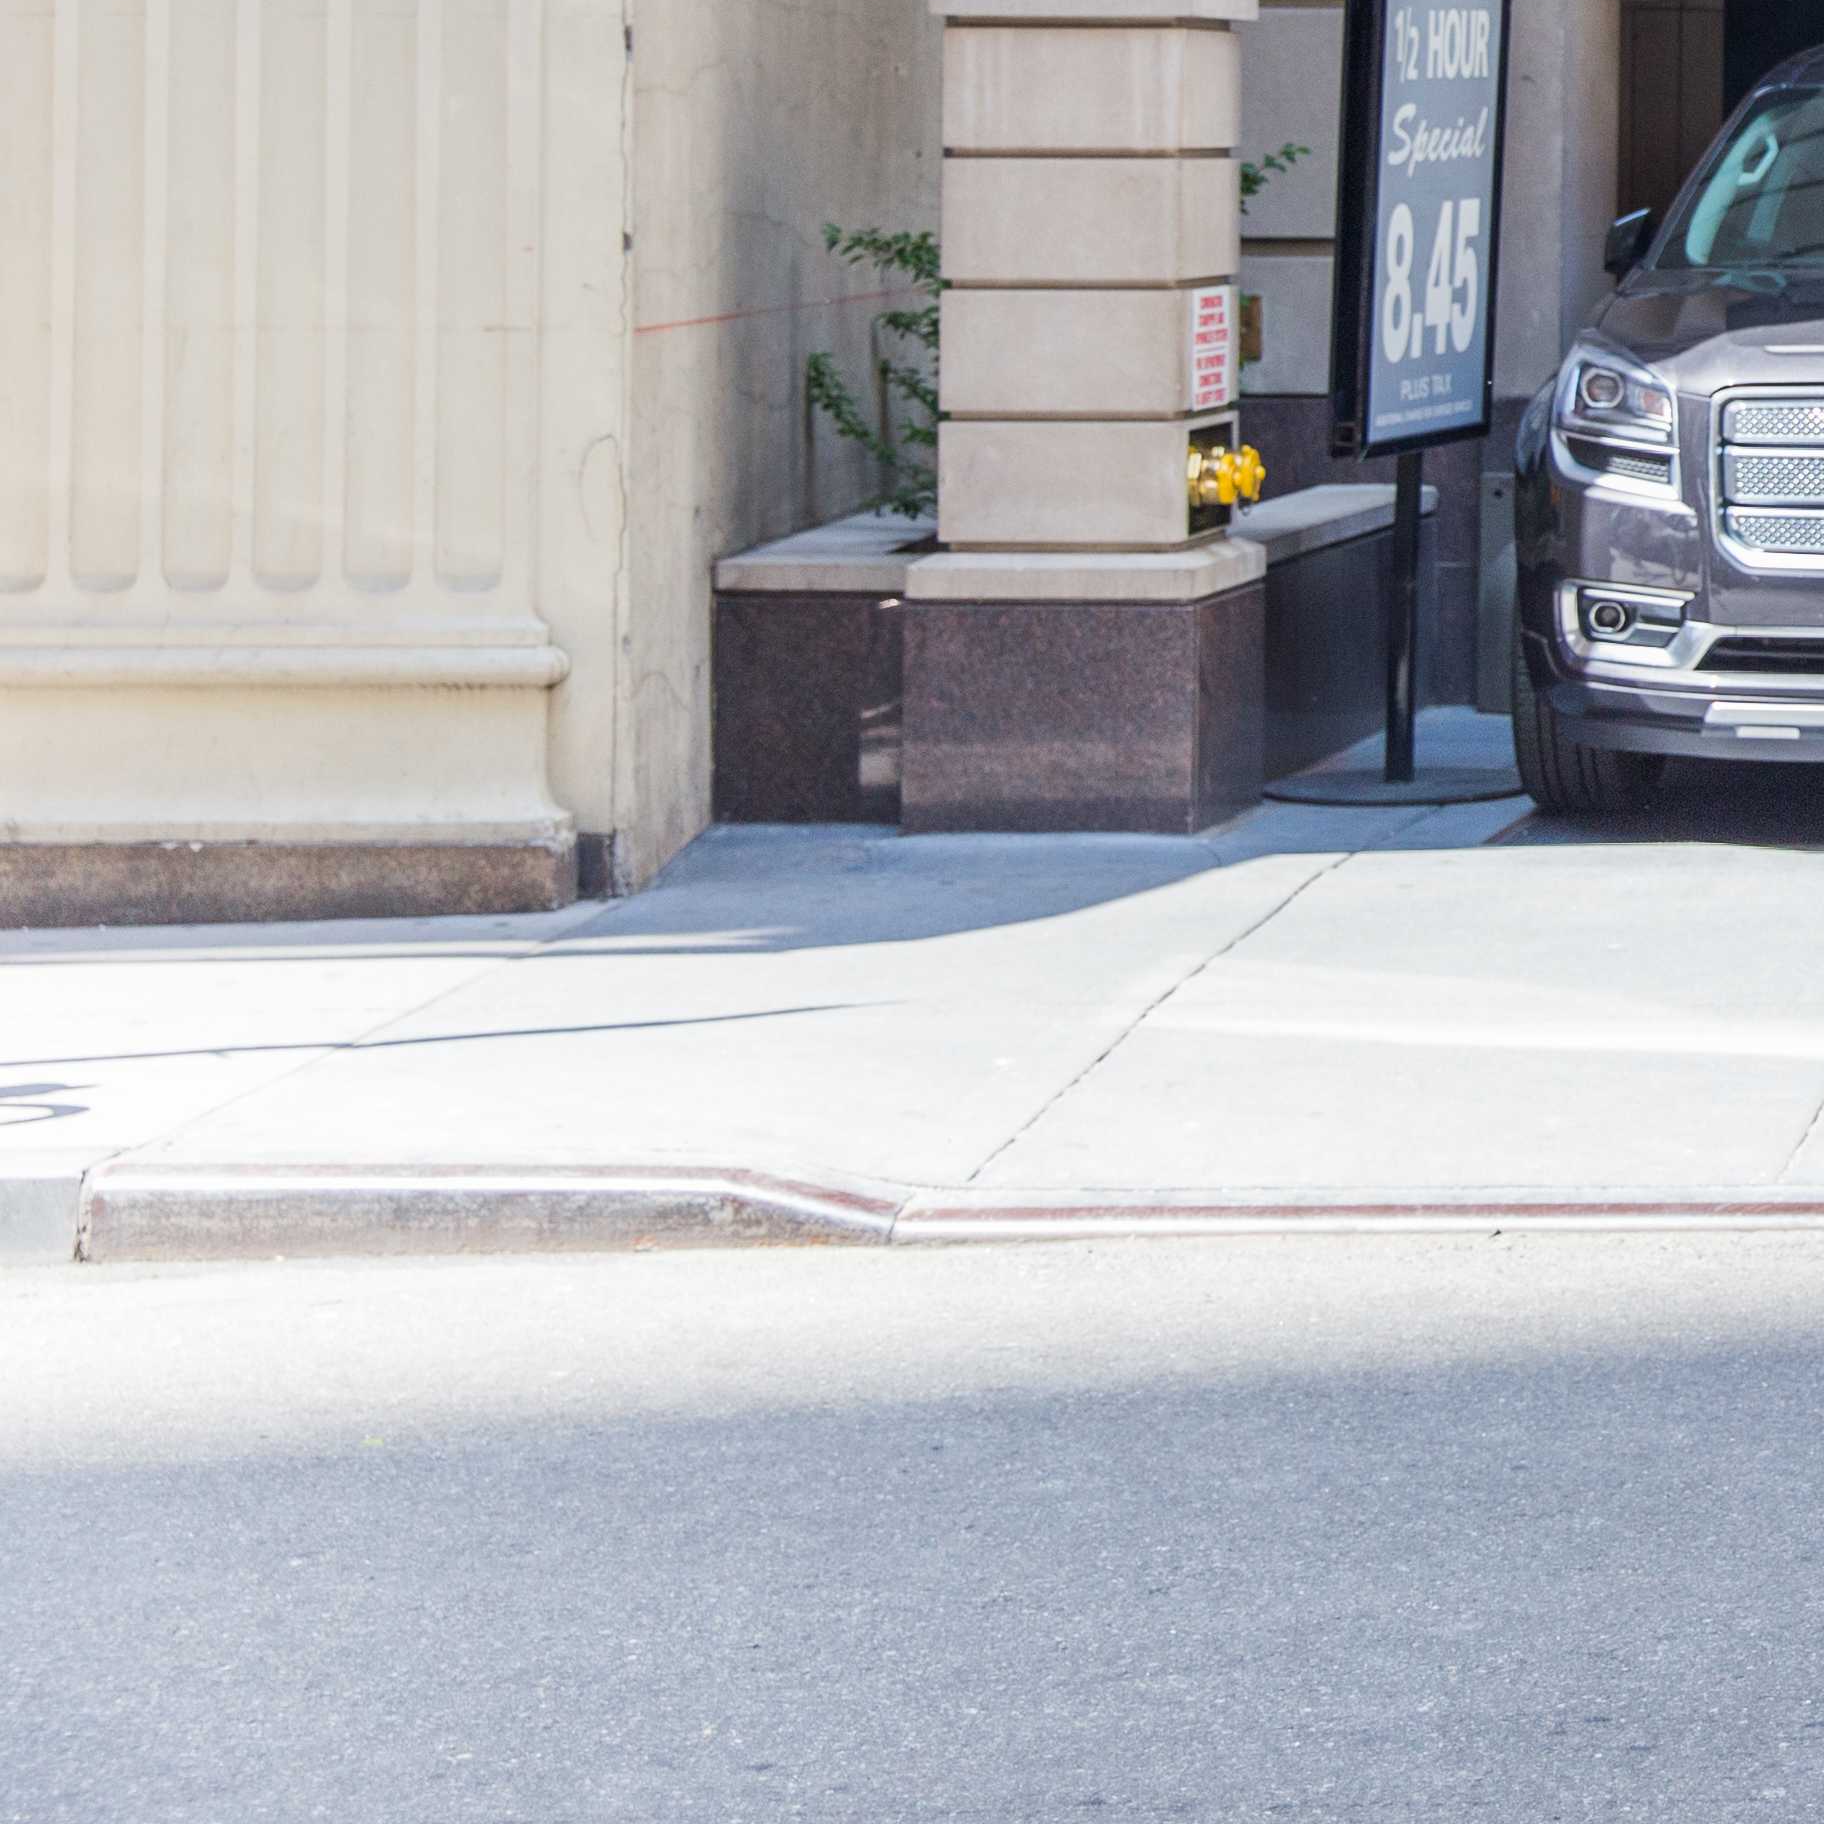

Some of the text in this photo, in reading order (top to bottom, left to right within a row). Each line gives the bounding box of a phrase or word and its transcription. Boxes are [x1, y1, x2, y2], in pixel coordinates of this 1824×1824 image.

[1426, 8, 1490, 80] HOUR
[1387, 102, 1489, 178] Special
[1382, 197, 1480, 364] 8.45
